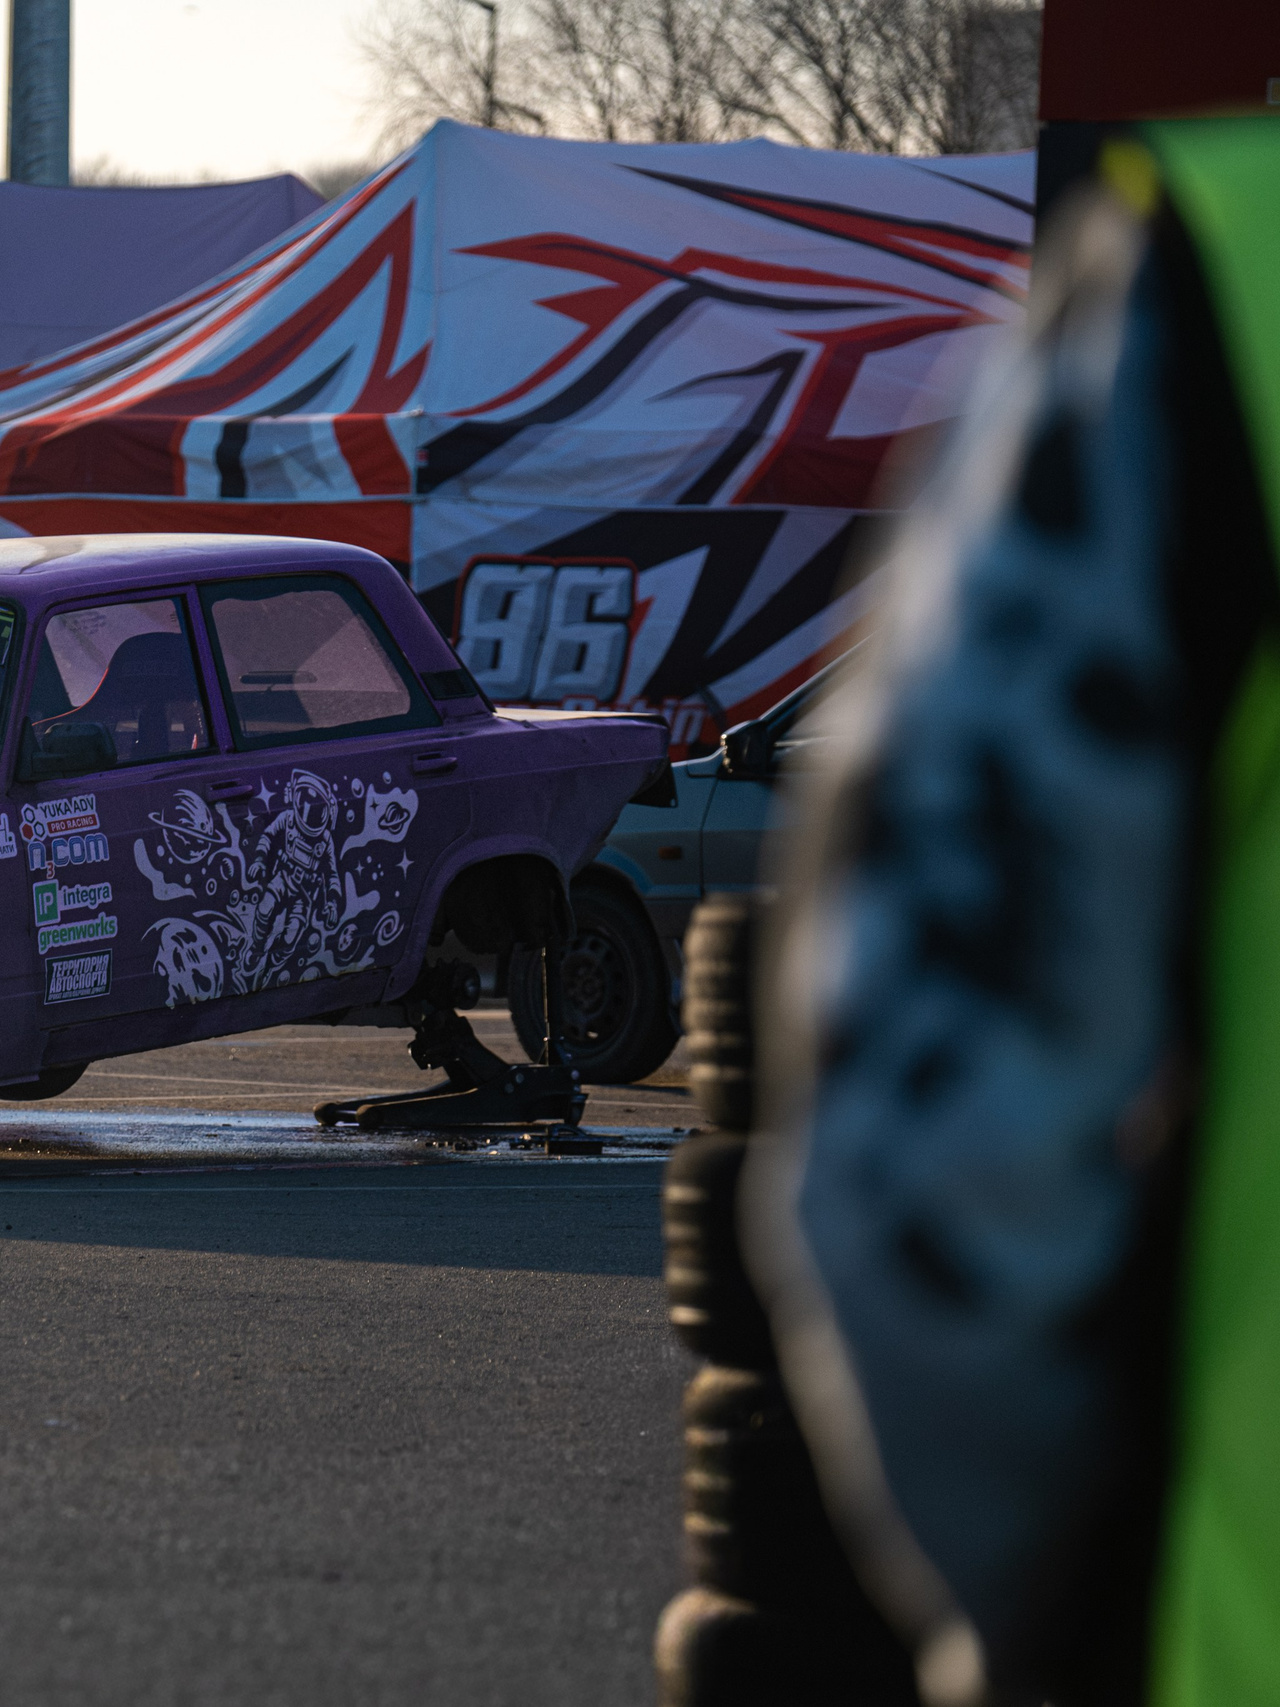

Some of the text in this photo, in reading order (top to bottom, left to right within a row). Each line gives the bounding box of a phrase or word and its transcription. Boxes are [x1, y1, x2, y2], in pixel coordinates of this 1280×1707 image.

[457, 563, 633, 700] 86
[40, 797, 94, 818] YUKA ADV
[51, 816, 94, 832] PRO RACING
[63, 885, 110, 906] integra
[39, 916, 116, 951] greenworks
[51, 954, 109, 978] ТЕРРИТОРИЯ
[49, 970, 108, 994] АВТОСПОРТА
